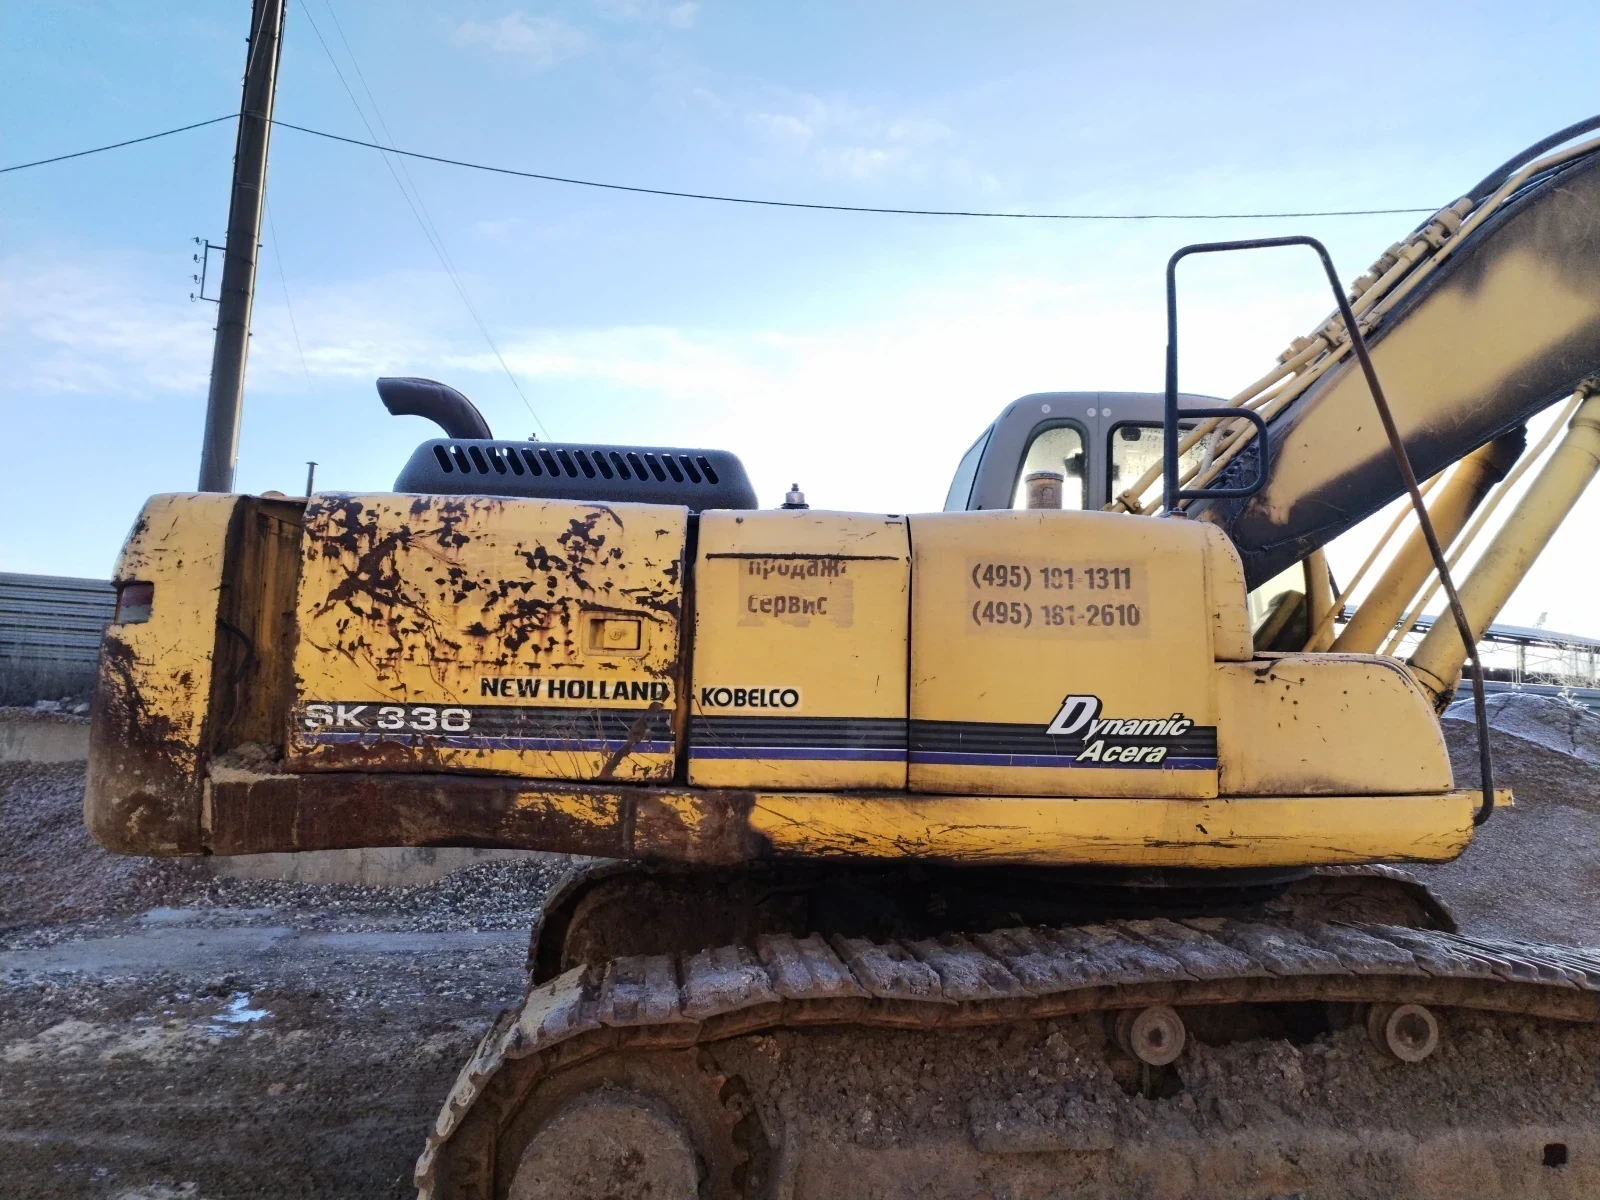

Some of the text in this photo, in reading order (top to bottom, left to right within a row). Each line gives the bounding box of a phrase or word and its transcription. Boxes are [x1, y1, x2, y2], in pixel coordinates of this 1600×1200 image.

[972, 563, 1032, 591] (495)
[748, 594, 828, 618] сервис
[972, 600, 1033, 628] (495)
[480, 677, 669, 701] NEW HOLLAND
[701, 687, 800, 708] KOBELCO
[304, 704, 472, 732] SK 330
[1046, 695, 1192, 741] Dynamic
[1075, 739, 1168, 764] Acera
